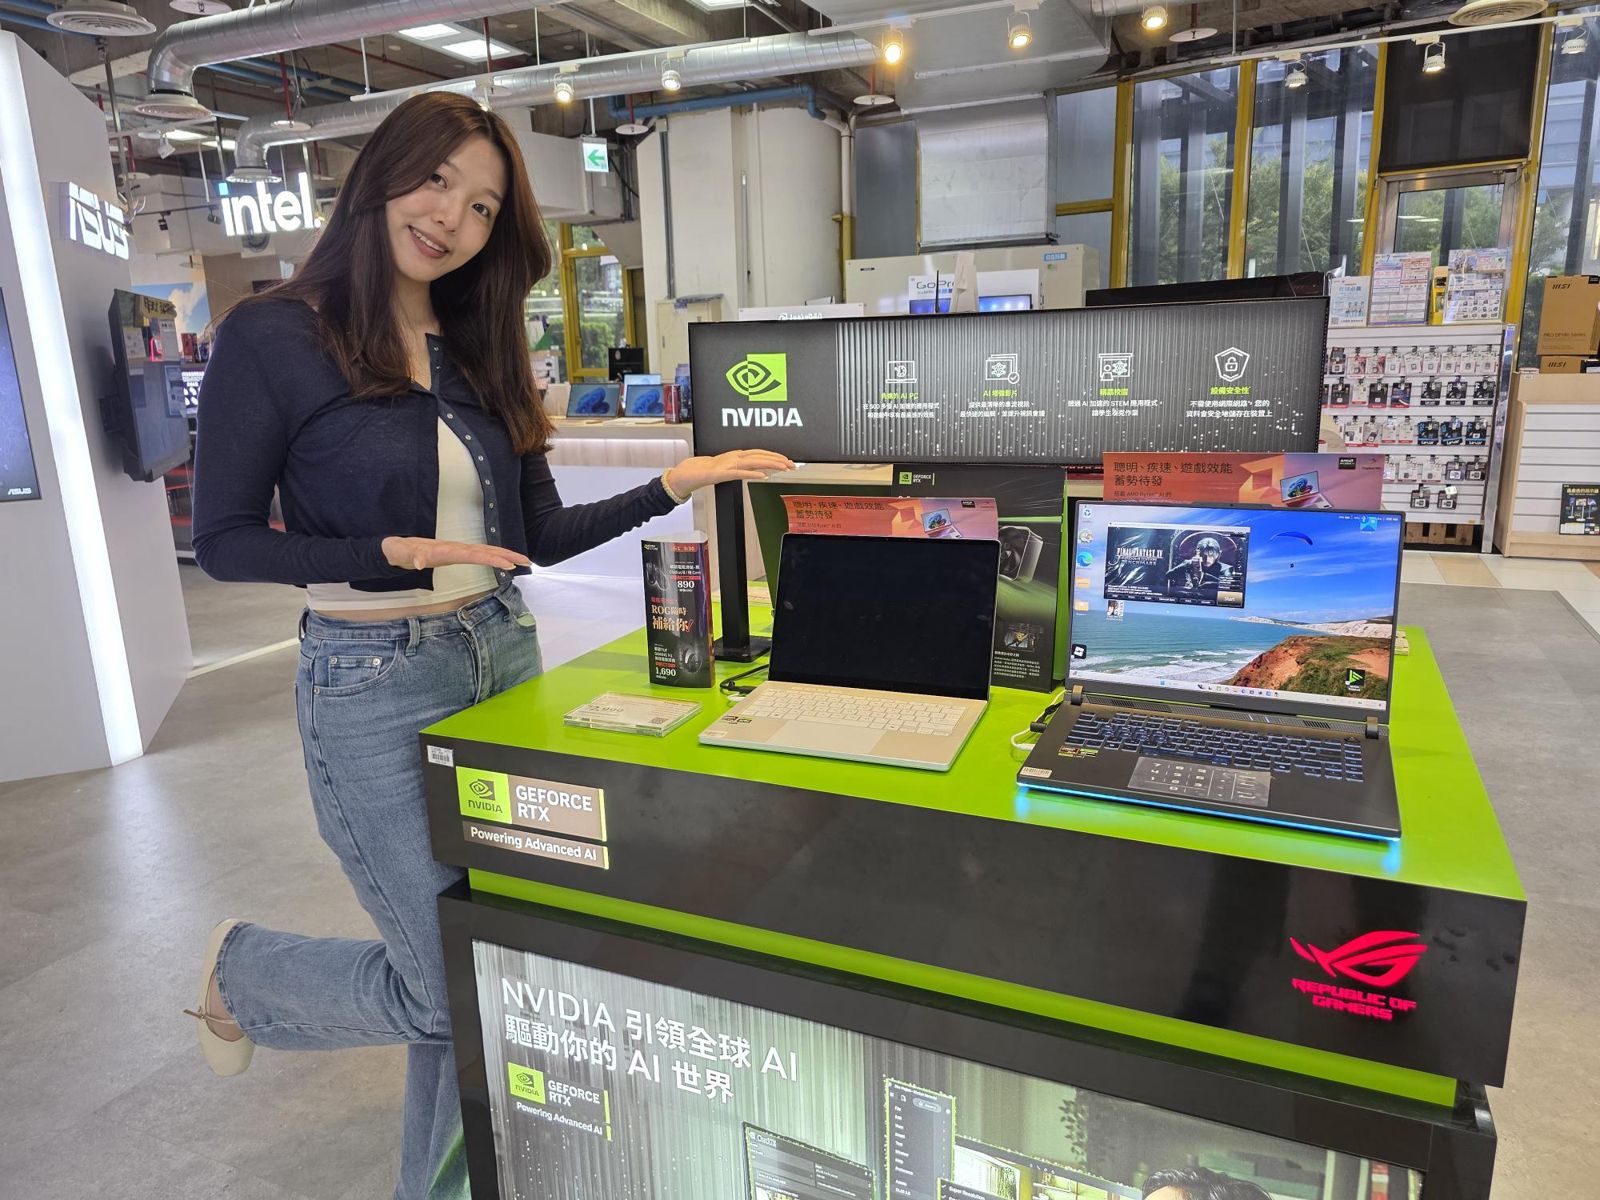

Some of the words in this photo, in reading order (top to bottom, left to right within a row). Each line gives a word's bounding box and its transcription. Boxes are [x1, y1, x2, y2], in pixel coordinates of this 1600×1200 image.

[69, 181, 129, 260] ASUS
[721, 408, 804, 427] NVIDIA
[1114, 462, 1233, 474] 聰明、疾速、遊戲效能
[1114, 475, 1163, 487] 蓄勢待發
[7, 487, 32, 496] ASUS
[677, 580, 695, 589] 890
[655, 667, 677, 677] 1,690
[468, 799, 503, 814] NVIDIA
[515, 785, 593, 812] GEFORCE
[517, 803, 550, 822] RTX
[470, 826, 522, 849] Powering
[524, 834, 581, 857] Advanced
[583, 848, 597, 861] AI
[1291, 978, 1386, 1006] REPUBLIC
[1388, 997, 1417, 1012] OF
[1311, 994, 1393, 1021] GAMERS
[500, 977, 616, 1033] NVIDIA
[625, 1008, 752, 1069] 引領全球
[761, 1046, 798, 1083] AI
[504, 1013, 617, 1071] 驅動你的
[626, 1049, 661, 1084] AI
[671, 1059, 735, 1104] 世界
[514, 1084, 540, 1098] NVIDIA
[547, 1079, 601, 1105] GEFORCE
[548, 1091, 572, 1108] RTX
[516, 1101, 553, 1122] Powering
[553, 1112, 593, 1132] Advanced
[592, 1125, 603, 1136] AI
[948, 1186, 962, 1195] Super
